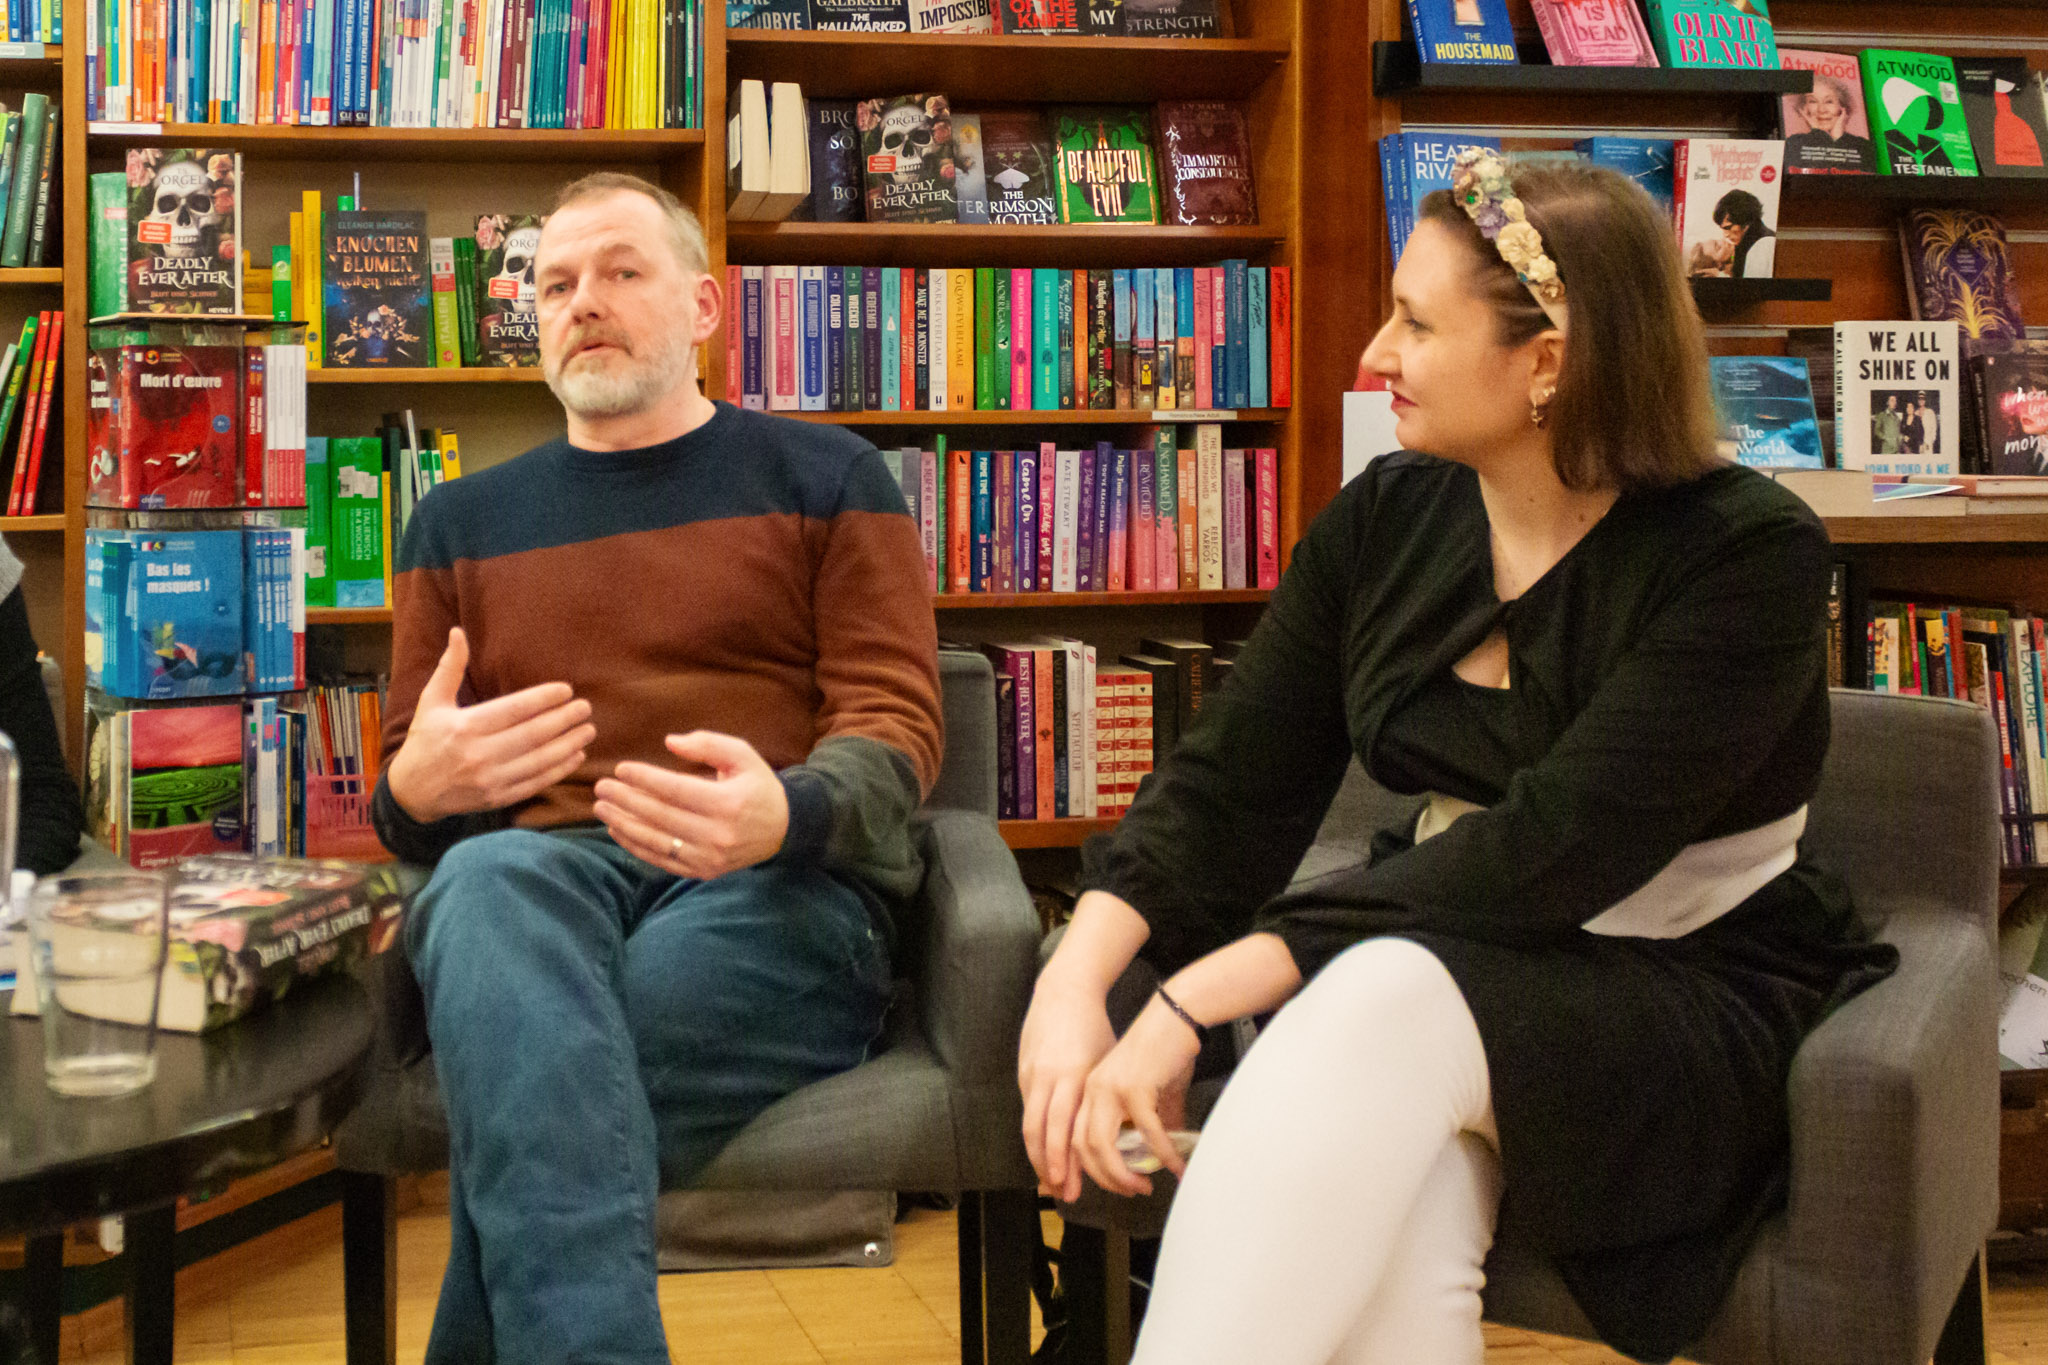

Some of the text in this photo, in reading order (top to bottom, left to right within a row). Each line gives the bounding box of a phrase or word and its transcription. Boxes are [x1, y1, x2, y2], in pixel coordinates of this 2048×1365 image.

[851, 13, 870, 22] THE
[1018, 12, 1078, 28] KNIFE
[1090, 10, 1116, 25] MY
[1128, 15, 1214, 32] STRENGTH
[1584, 6, 1606, 21] IS
[816, 21, 906, 32] HALLMARKED
[1464, 32, 1482, 41] THE
[1576, 25, 1628, 42] DEAD
[1673, 11, 1766, 42] OLIVIE
[1435, 43, 1514, 60] HOUSEMAID
[1678, 38, 1773, 68] BLAKE
[1782, 56, 1857, 80] Atwood
[1876, 60, 1952, 81] ATWOOD
[886, 114, 924, 128] ORGEL
[1182, 154, 1238, 168] IMMORTAL
[1706, 144, 1764, 166] Wuthering
[1898, 155, 1914, 163] THE
[1066, 149, 1146, 184] BEAUTIFUL
[1178, 167, 1250, 181] CONSEQUENCES
[1716, 164, 1754, 185] Heights
[1894, 163, 1977, 176] TESTAMENTS
[160, 174, 208, 188] ORGEL
[886, 178, 936, 196] DEADLY
[873, 188, 956, 208] EVER AFTER
[1003, 190, 1024, 200] THE
[1092, 183, 1126, 217] EVIL
[338, 222, 374, 230] ELEANOR
[988, 212, 1047, 224] MOTH
[336, 236, 419, 253] KNOCHEN
[154, 256, 213, 270] DEADLY
[343, 256, 412, 272] BLUMEN
[138, 270, 236, 290] EVER AFTER
[747, 280, 758, 296] LOVE
[806, 281, 818, 298] LOVE
[780, 280, 790, 336] LOVE UNWRITTEN
[916, 288, 927, 308] MAKE
[996, 279, 1006, 333] MORRIGAN
[1064, 279, 1072, 325] For Ones
[1215, 276, 1224, 335] Rock Boat
[747, 297, 758, 338] REDESIGNED
[806, 299, 818, 338] ARRANGED
[830, 294, 840, 328] COLLIDED
[848, 294, 859, 328] WRECKED
[866, 291, 876, 328] REDEEMED
[916, 310, 927, 320] ME
[1097, 310, 1106, 326] Ever
[440, 296, 450, 345] ITALIEN
[955, 274, 966, 368] GLOW EVERFLAME
[490, 326, 528, 342] EVER
[934, 313, 943, 366] EVERFLAME
[1868, 331, 1941, 352] WE ALL
[916, 331, 927, 366] MONSTER
[1836, 331, 1844, 413] WE ALL SHINE ON
[1859, 359, 1950, 380] SHINE ON
[140, 373, 170, 388] Mort
[2004, 386, 2048, 407] when
[1730, 424, 1765, 439] The
[1736, 440, 1786, 455] World
[1002, 454, 1010, 486] BUSINESS
[1100, 464, 1108, 486] YOU'VE
[1116, 454, 1125, 476] Paige
[1210, 436, 1218, 494] THE THINGS WE
[1864, 464, 1889, 474] JOHN
[1895, 464, 1921, 474] YOKO
[1936, 464, 1950, 474] ME
[980, 457, 988, 495] PRIME TIME
[1158, 442, 1173, 512] UNCHARMED
[1202, 454, 1210, 500] UNFINISHED
[1020, 458, 1036, 524] Game On
[1041, 486, 1051, 500] THE
[1063, 459, 1072, 529] KATE STEWART
[1140, 464, 1152, 521] REWITCHED
[1262, 453, 1273, 548] THE NIGHT IN QUESTION
[356, 508, 363, 516] IN
[364, 508, 372, 560] ITALIENISCH
[1236, 526, 1242, 538] WE
[1041, 537, 1052, 558] GAME
[1202, 529, 1210, 564] YARROS
[1211, 526, 1219, 566] REBECCA
[146, 562, 192, 576] Bas les
[146, 578, 210, 594] masques !
[2021, 648, 2037, 728] EXPLORE
[1018, 657, 1031, 742] BEST HEX EVER
[1088, 707, 1096, 761] SPECTACULAR
[1101, 688, 1114, 784] LEGENDARY
[1120, 686, 1131, 782] LEGENDARY
[1137, 696, 1148, 764] FINALE
[1072, 712, 1082, 771] SPECTACULAR
